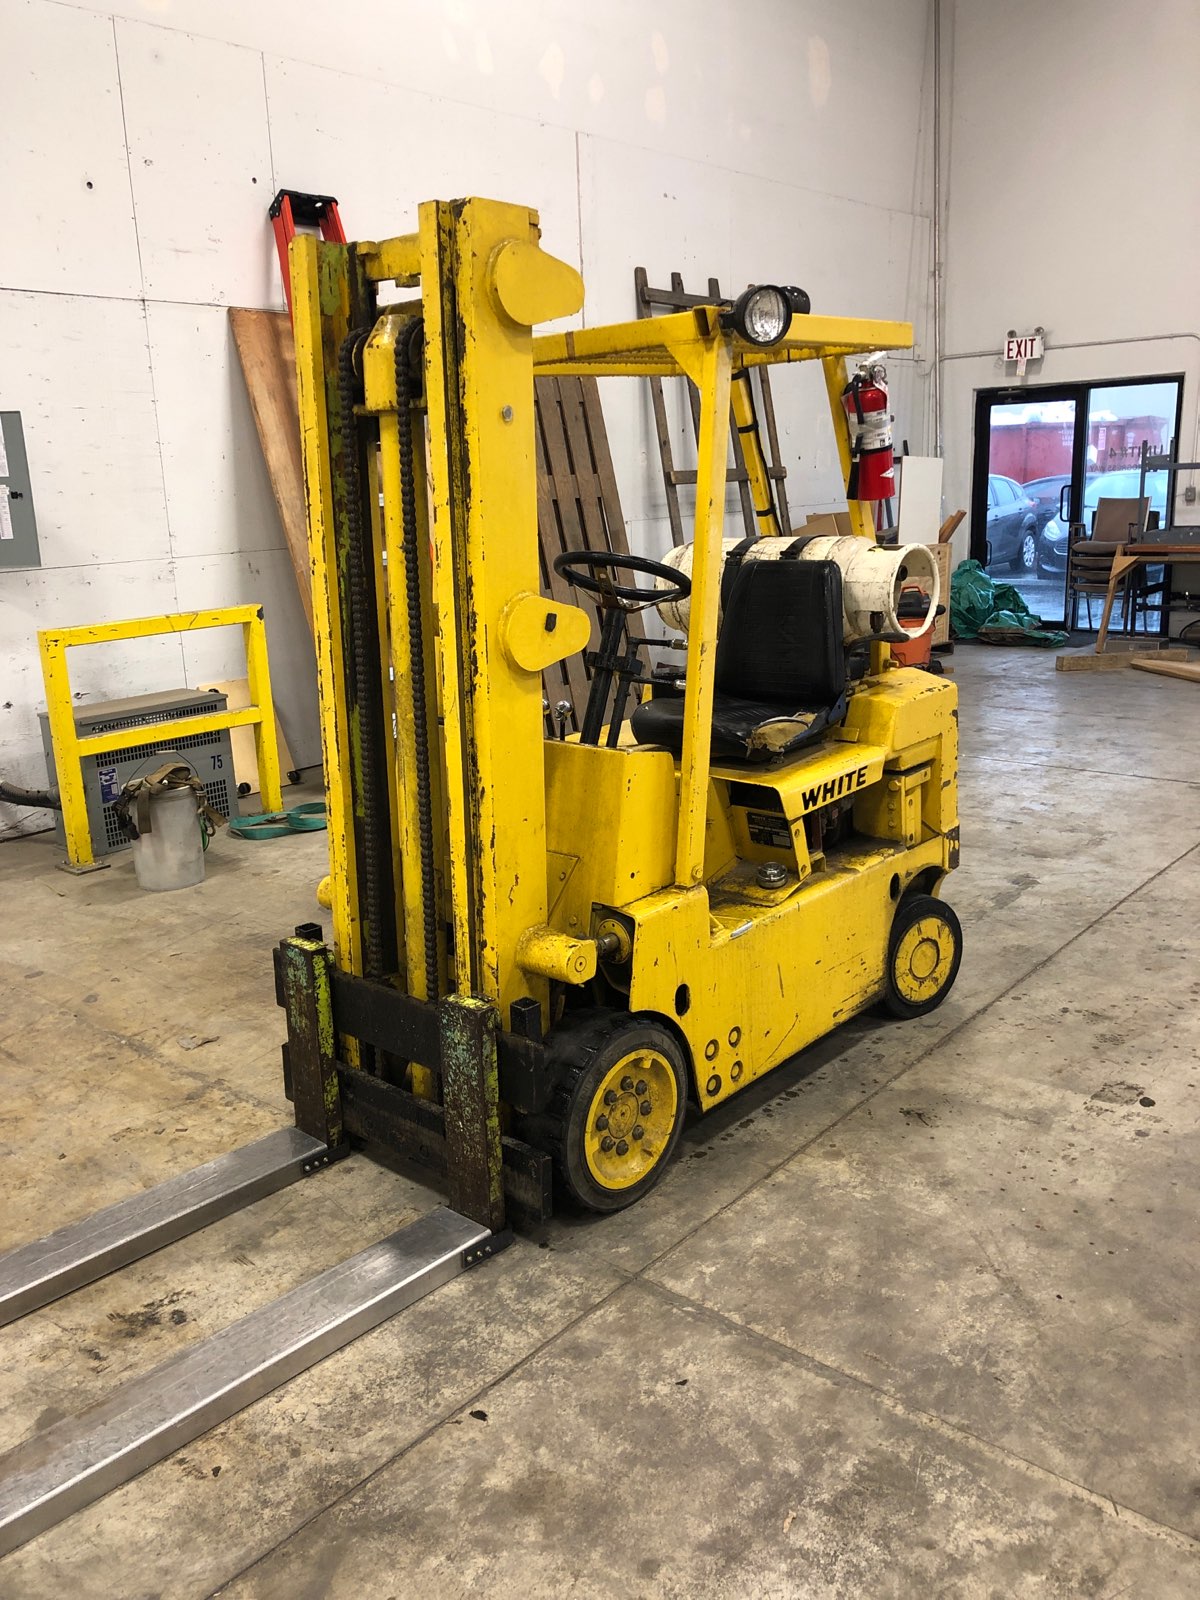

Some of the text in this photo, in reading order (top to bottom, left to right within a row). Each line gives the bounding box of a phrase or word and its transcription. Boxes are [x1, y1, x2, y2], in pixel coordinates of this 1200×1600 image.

[1007, 338, 1036, 359] EXIT
[211, 755, 223, 770] 75
[801, 765, 868, 810] WHITE
